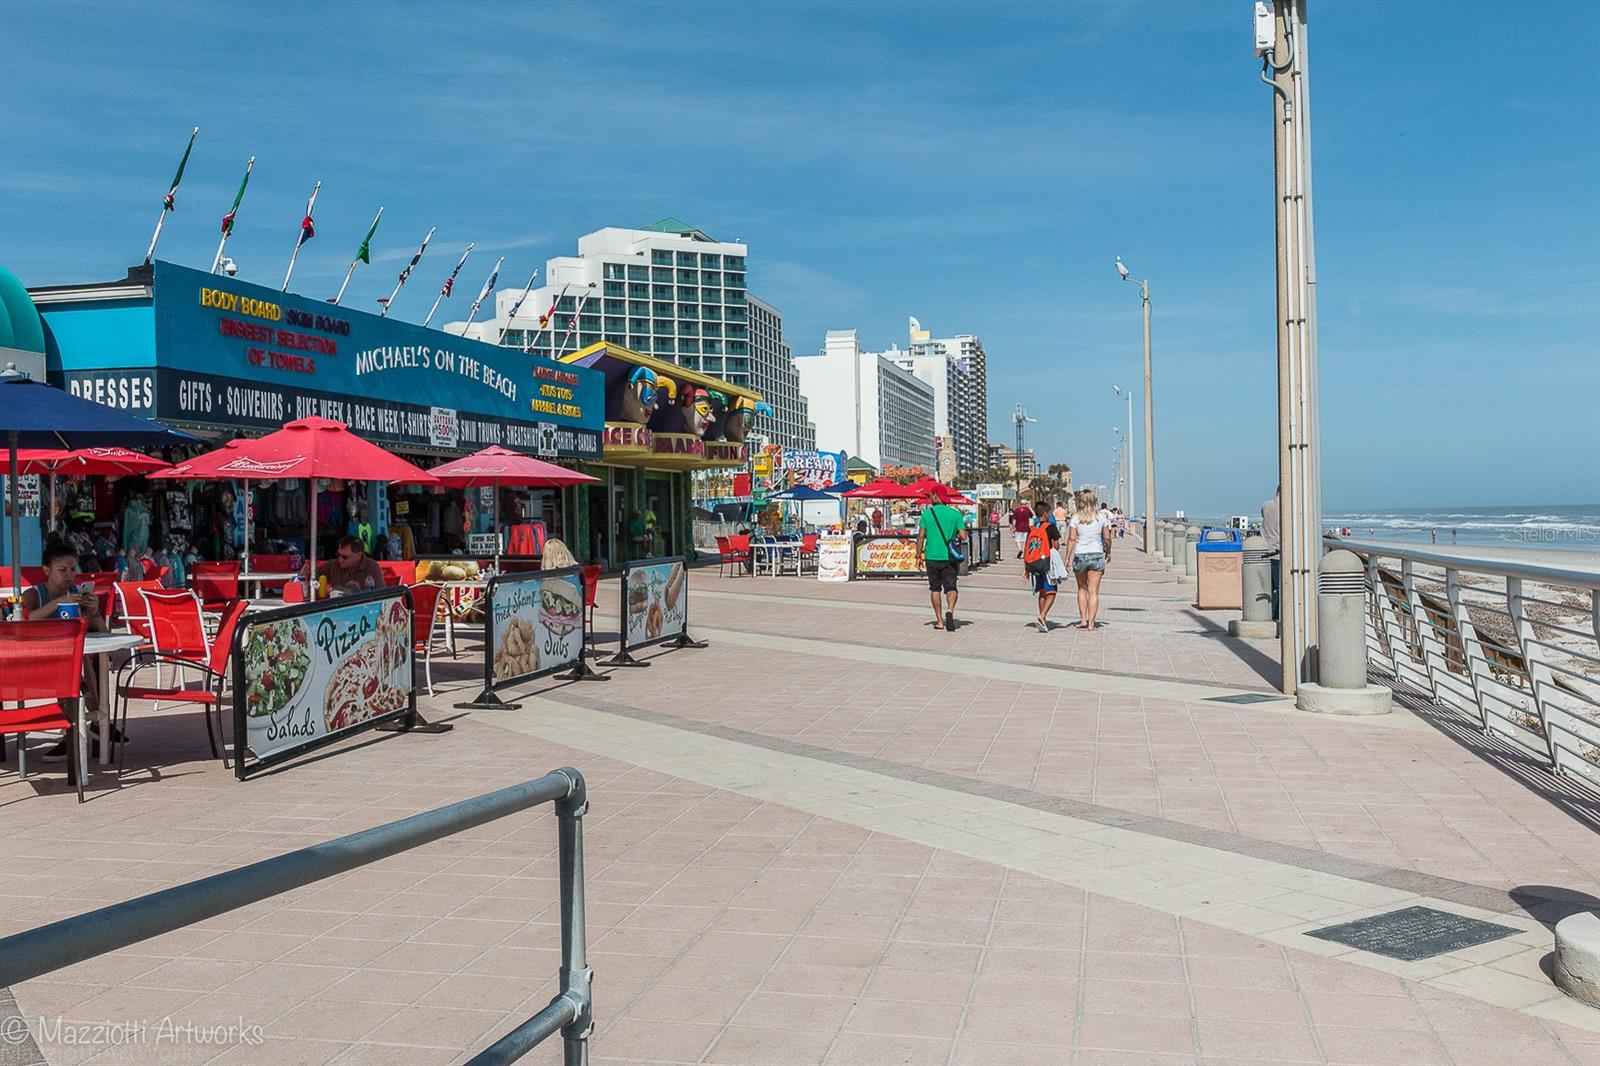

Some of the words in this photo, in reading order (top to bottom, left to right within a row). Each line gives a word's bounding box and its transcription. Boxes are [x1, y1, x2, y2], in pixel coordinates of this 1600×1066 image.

[202, 287, 239, 312] BODY
[241, 296, 281, 321] BOARD
[315, 314, 350, 336] BOARD
[220, 318, 273, 344] BIGGEST
[276, 328, 338, 355] SELECTION
[247, 348, 266, 367] OF
[268, 351, 315, 374] TOWELS
[356, 345, 431, 376] MICHAEL'S
[434, 349, 455, 372] ON
[458, 355, 480, 379] THE
[482, 368, 517, 402] BEACH
[70, 376, 153, 410] DRESSES
[179, 380, 212, 414] GIFTS
[226, 386, 284, 421] SOUVENIRS
[296, 395, 318, 420] BIKE
[320, 399, 344, 423] WEEK
[355, 404, 376, 431] RACE
[377, 408, 399, 434] WEEK
[400, 411, 432, 437] T-SHIRTS
[460, 419, 477, 442] SWIM
[478, 421, 501, 444] TRUNKS
[438, 424, 449, 436] 500
[603, 427, 632, 446] ICE
[708, 445, 739, 460] FUN
[787, 457, 834, 471] CREAM
[494, 598, 512, 625] Fried
[512, 587, 538, 614] Shrimp
[317, 614, 371, 665] Pizza
[543, 622, 569, 659] Subs
[267, 705, 316, 742] Salads
